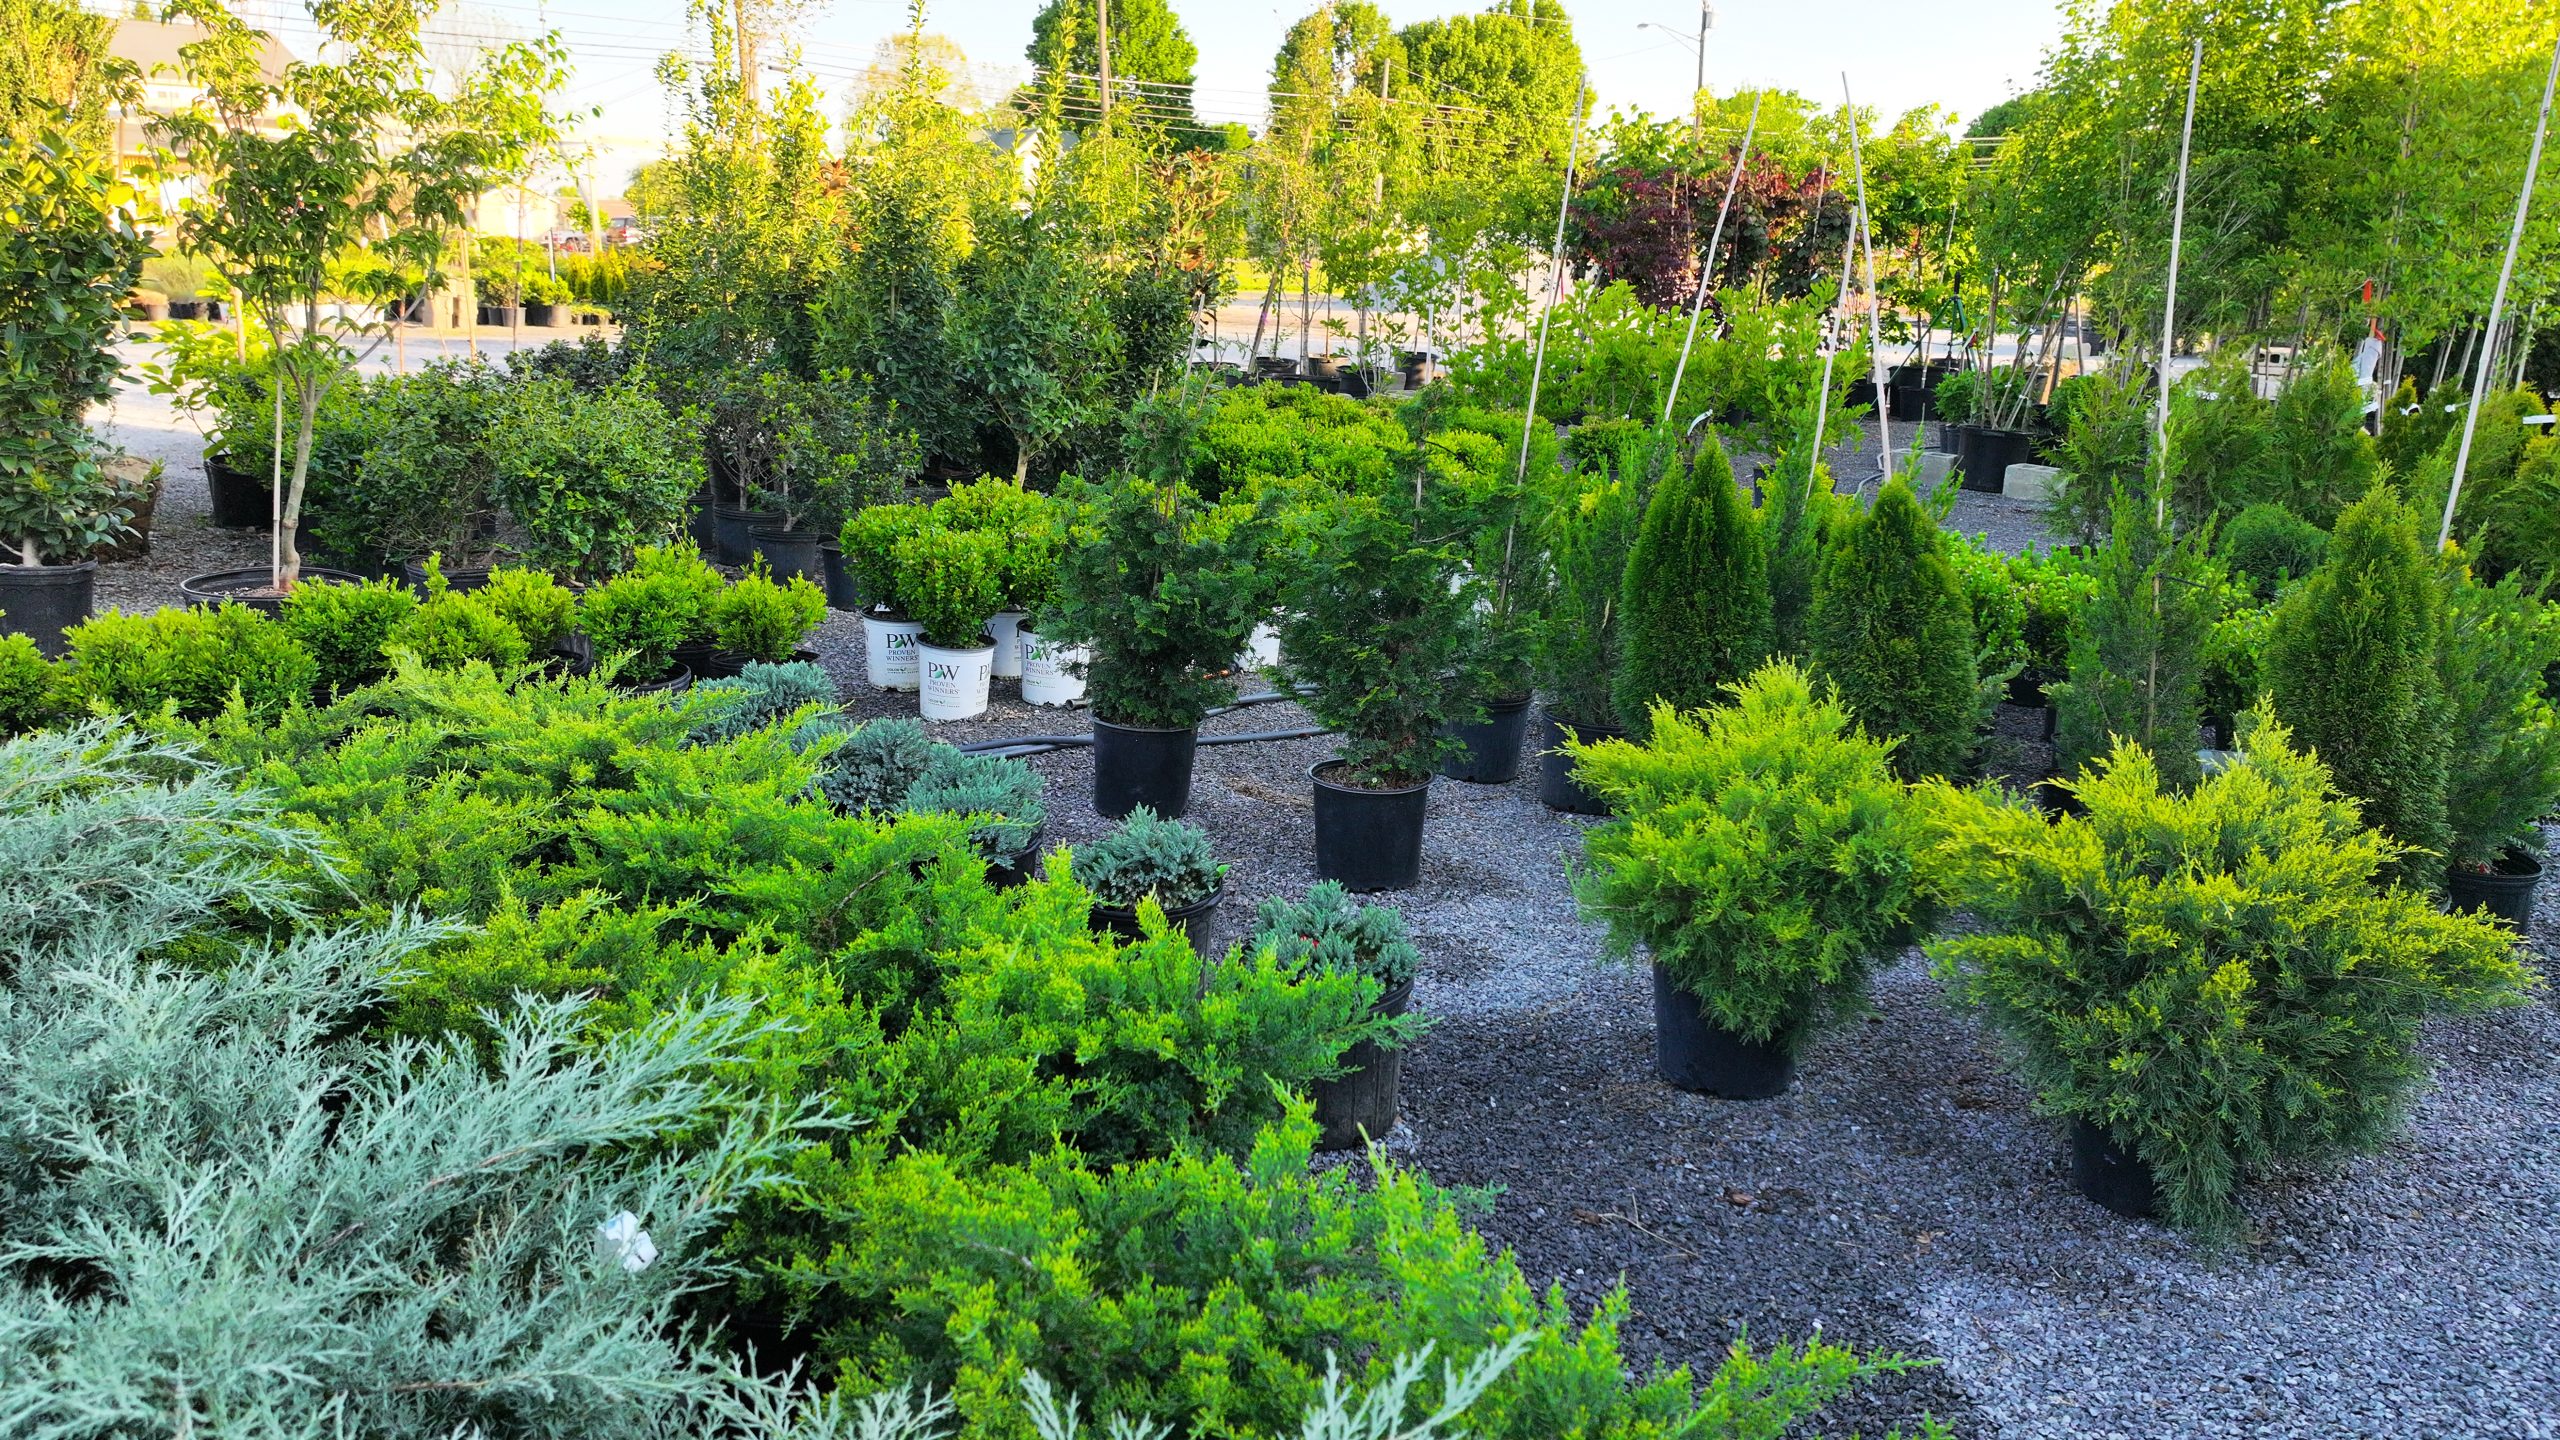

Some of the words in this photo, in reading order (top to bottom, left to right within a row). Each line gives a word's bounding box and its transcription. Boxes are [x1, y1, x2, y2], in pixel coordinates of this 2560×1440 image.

[886, 633, 917, 649] PW
[1025, 643, 1056, 662] PW
[1026, 660, 1052, 669] PROVEN
[928, 661, 960, 681] PW
[928, 685, 959, 694] WINNERS
[929, 680, 956, 688] PROVEN
